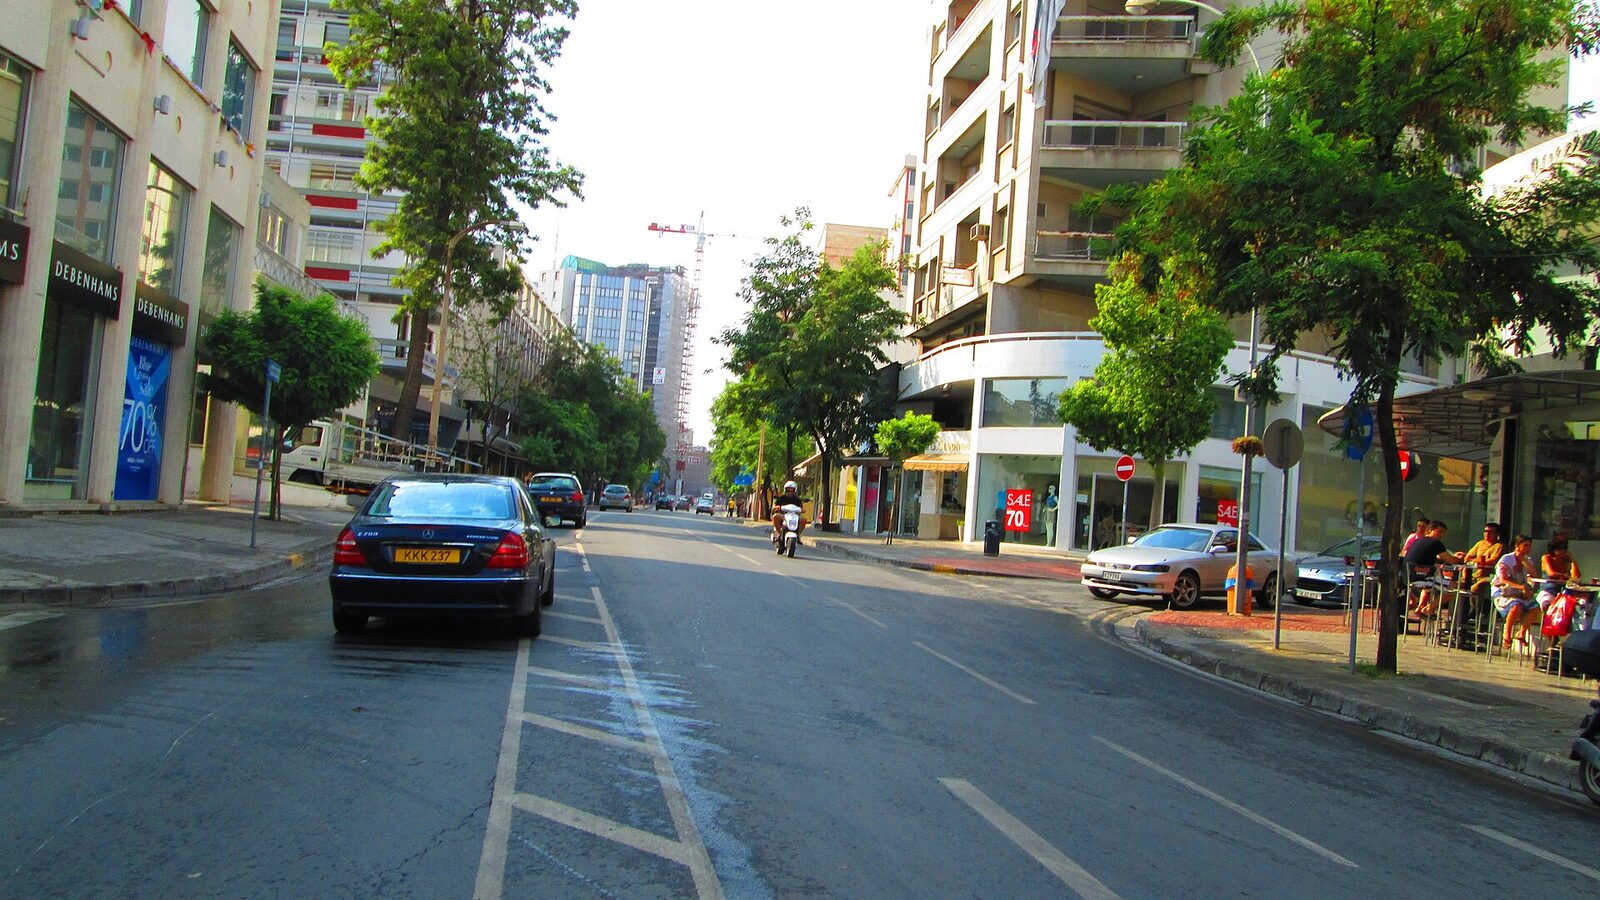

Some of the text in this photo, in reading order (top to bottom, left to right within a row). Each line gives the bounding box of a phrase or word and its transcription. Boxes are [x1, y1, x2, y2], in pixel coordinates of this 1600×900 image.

[55, 261, 118, 301] DEBENHAMS
[138, 298, 185, 329] DEBENHAMS
[1006, 493, 1031, 507] SALE
[1006, 509, 1024, 527] 70
[1217, 504, 1238, 519] SALE
[404, 550, 451, 562] KKK 237
